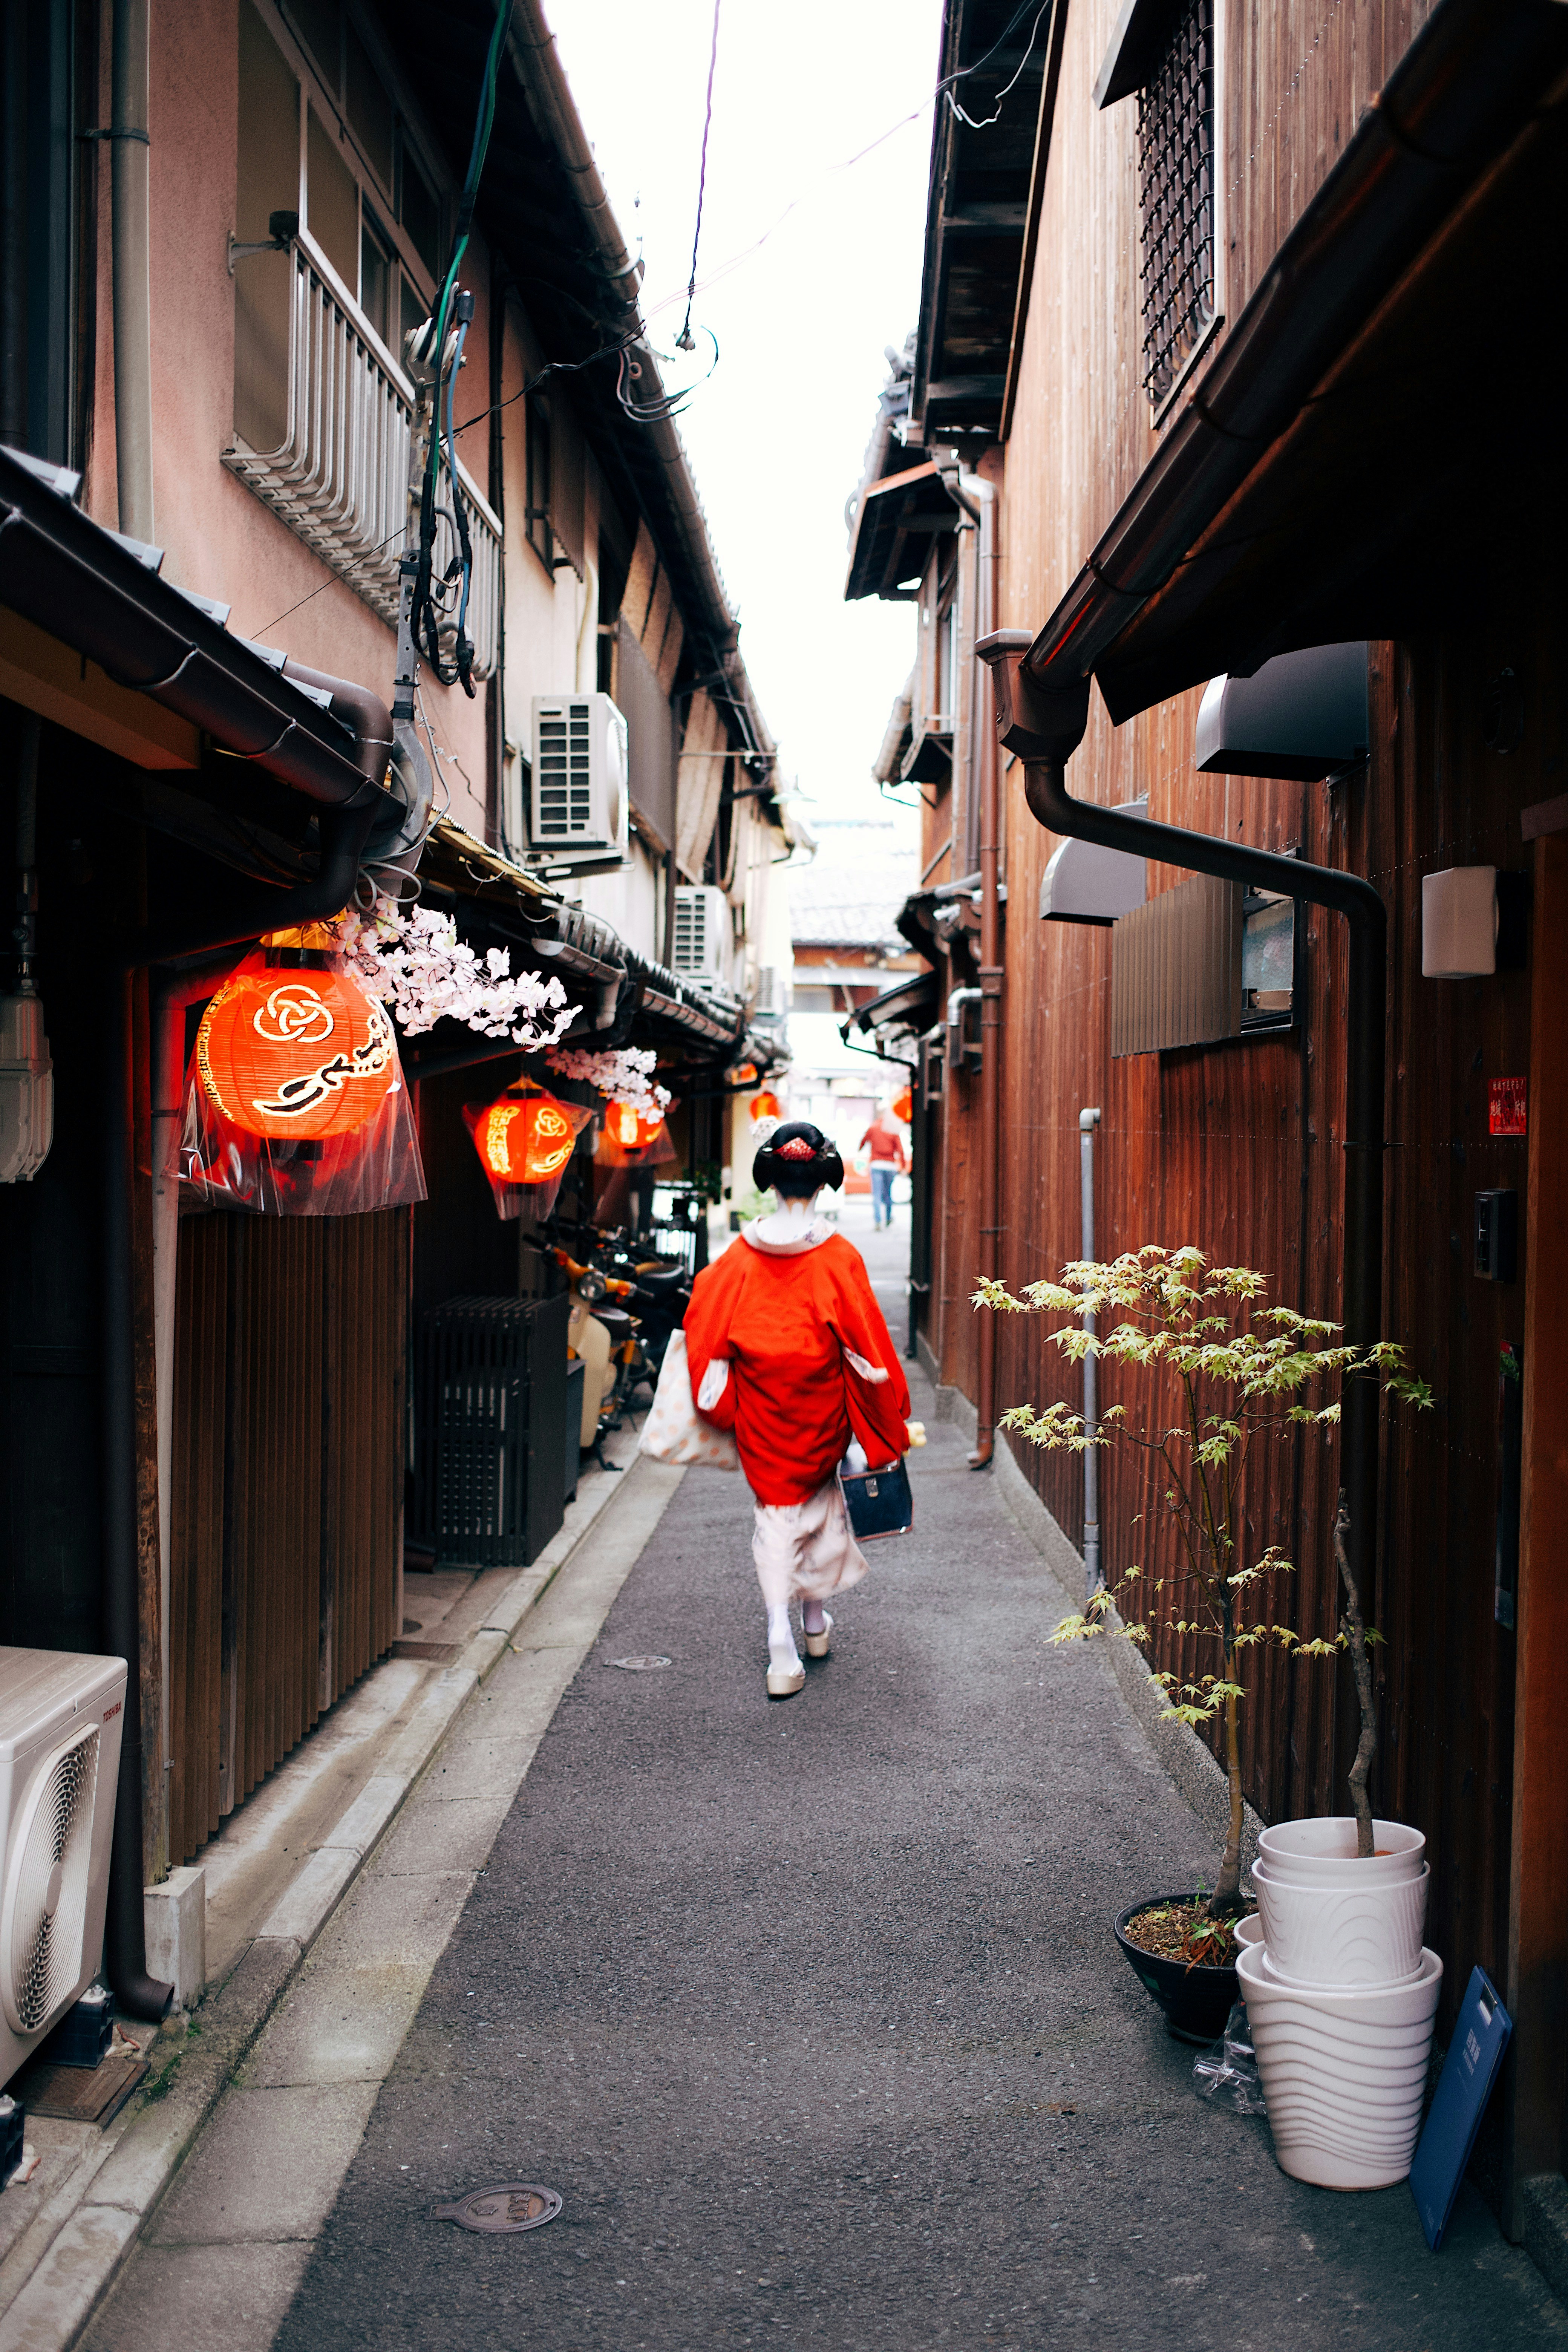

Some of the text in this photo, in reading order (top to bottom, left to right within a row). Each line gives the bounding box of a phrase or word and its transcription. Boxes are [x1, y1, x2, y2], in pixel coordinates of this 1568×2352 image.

[103, 1701, 121, 1723] TOSHIBA
[1466, 2028, 1481, 2065] 回覧板
